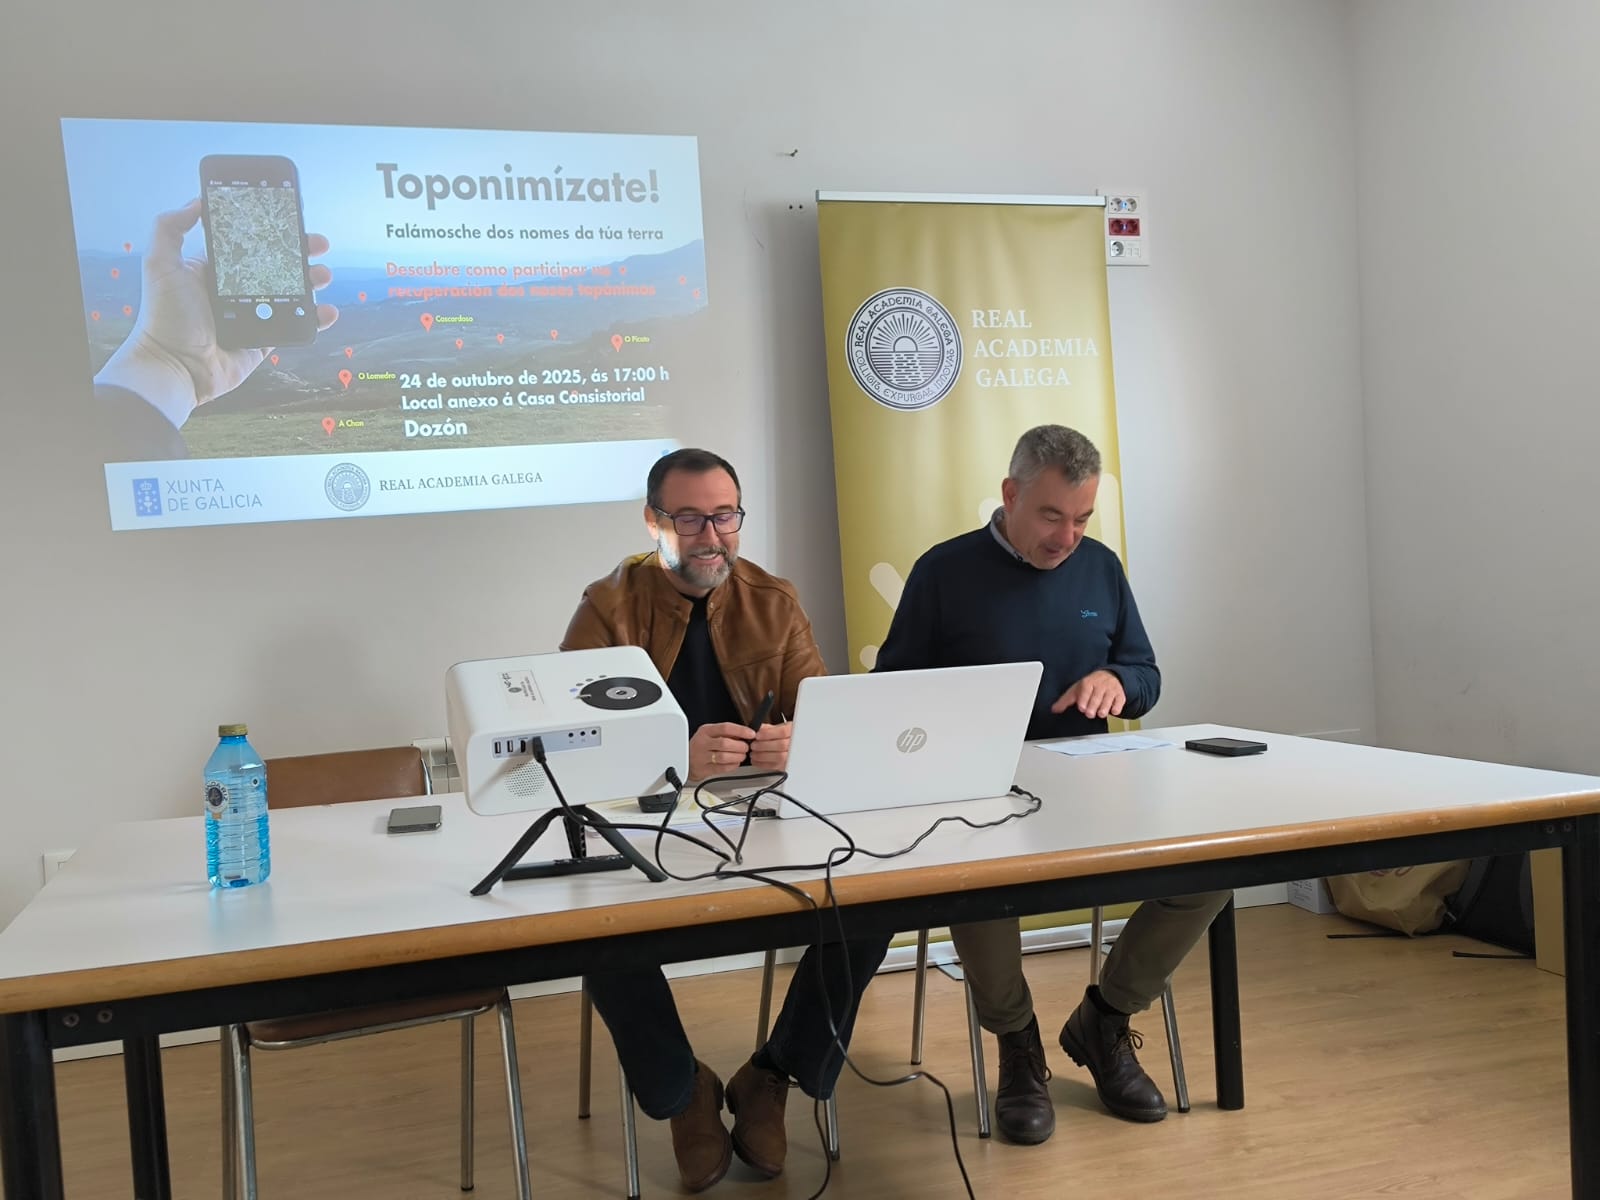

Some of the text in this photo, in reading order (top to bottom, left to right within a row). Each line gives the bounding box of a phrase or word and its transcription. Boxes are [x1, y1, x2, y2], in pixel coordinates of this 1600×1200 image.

[375, 162, 660, 210] Toponimízate!
[386, 223, 664, 241] Falámosche dos nomes da túa terra
[386, 261, 460, 277] Descubre
[466, 264, 508, 276] como
[513, 262, 588, 279] participar
[855, 296, 953, 347] REAL ACADEMIA GALEGA
[971, 309, 1032, 329] REAL
[972, 338, 1099, 358] ACADEMIA
[399, 365, 670, 389] 24 de outubro de 2025, ás 17:00 h
[975, 367, 1071, 388] GALEGA
[401, 386, 646, 410] Local anexo á Casa Consistorial
[404, 417, 469, 437] Dozón
[165, 478, 225, 495] XUNTA
[379, 471, 544, 492] REAL ACADEMIA GALEGA
[167, 494, 263, 512] DE GALICIA
